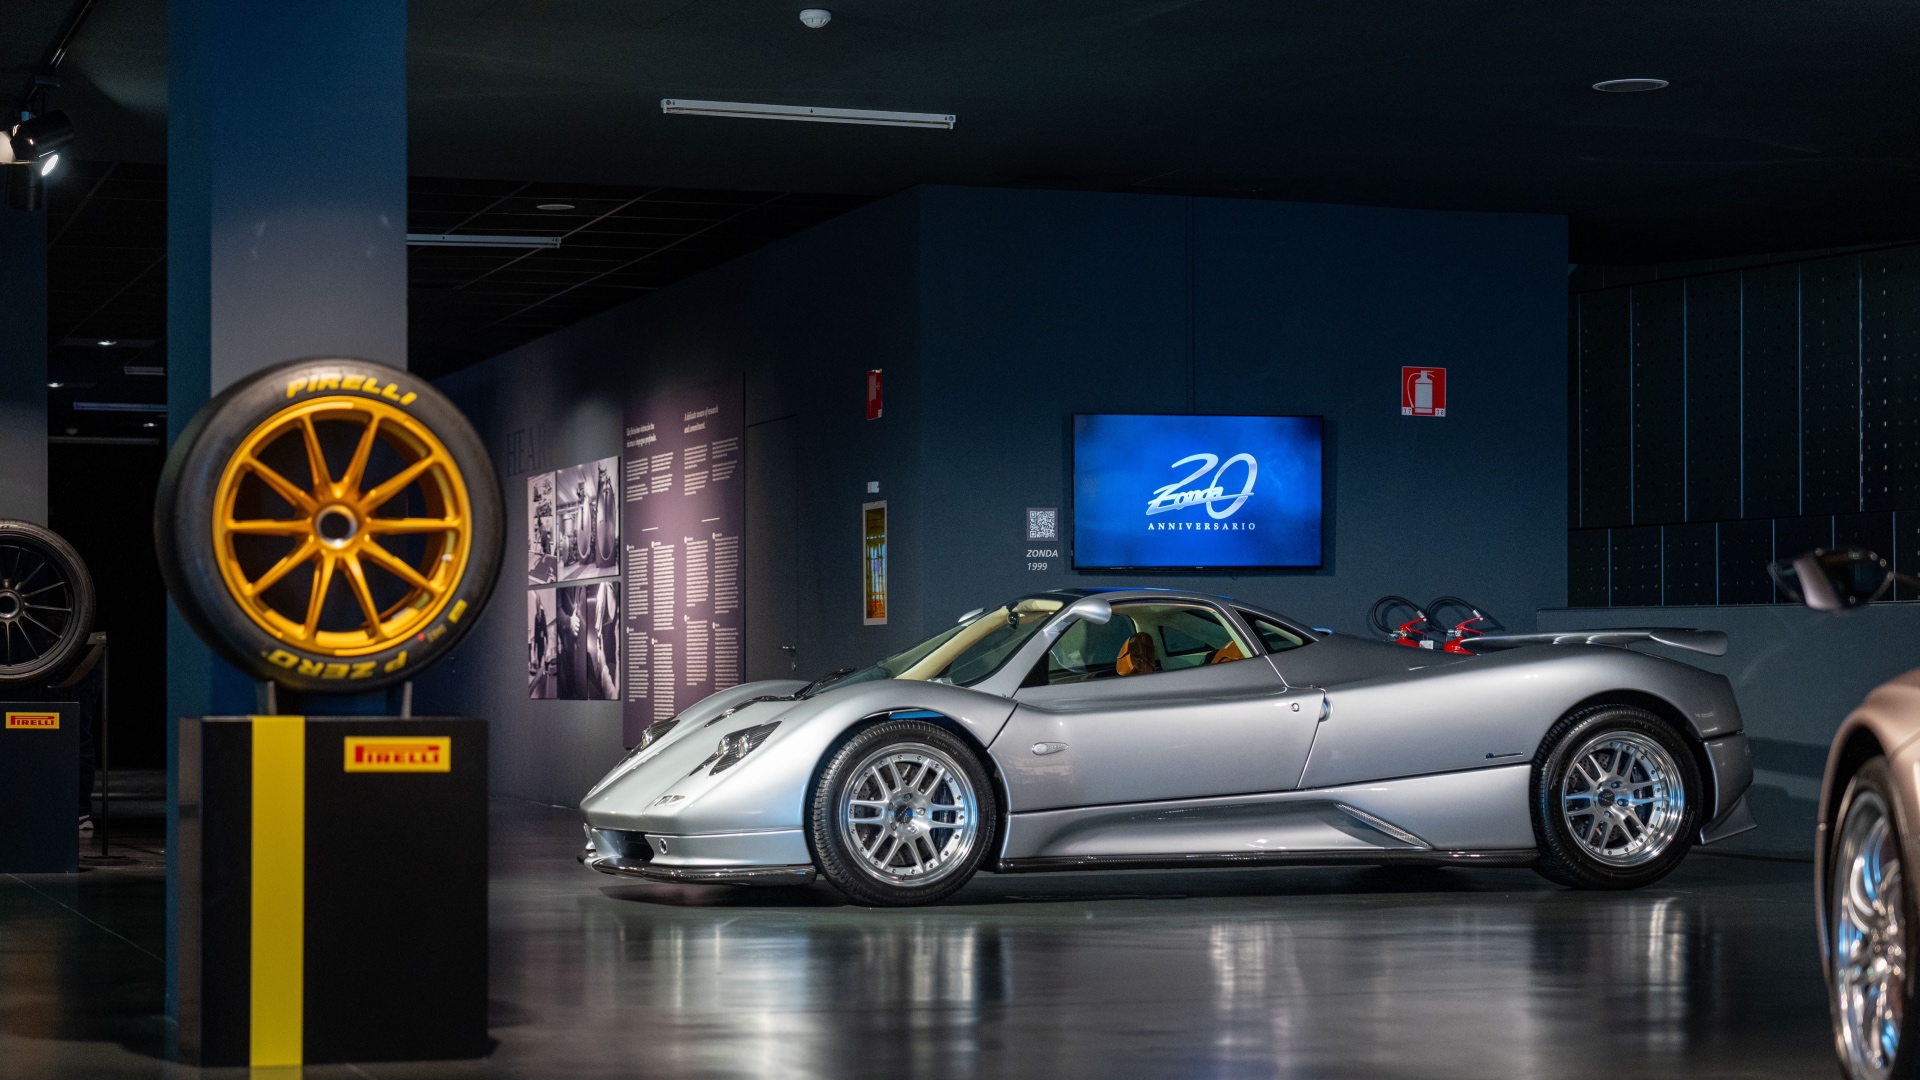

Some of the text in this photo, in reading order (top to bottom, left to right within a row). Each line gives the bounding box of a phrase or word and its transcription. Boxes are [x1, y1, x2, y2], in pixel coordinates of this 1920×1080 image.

[286, 372, 418, 405] PIRELLI
[1150, 453, 1257, 519] 20
[1146, 484, 1254, 515] Zonda
[1148, 522, 1256, 531] ANNIVERSARIO
[1026, 549, 1059, 558] ZONDA
[1027, 562, 1048, 571] 1999
[10, 716, 55, 726] PIRELLI
[355, 744, 440, 763] PIRELLI
